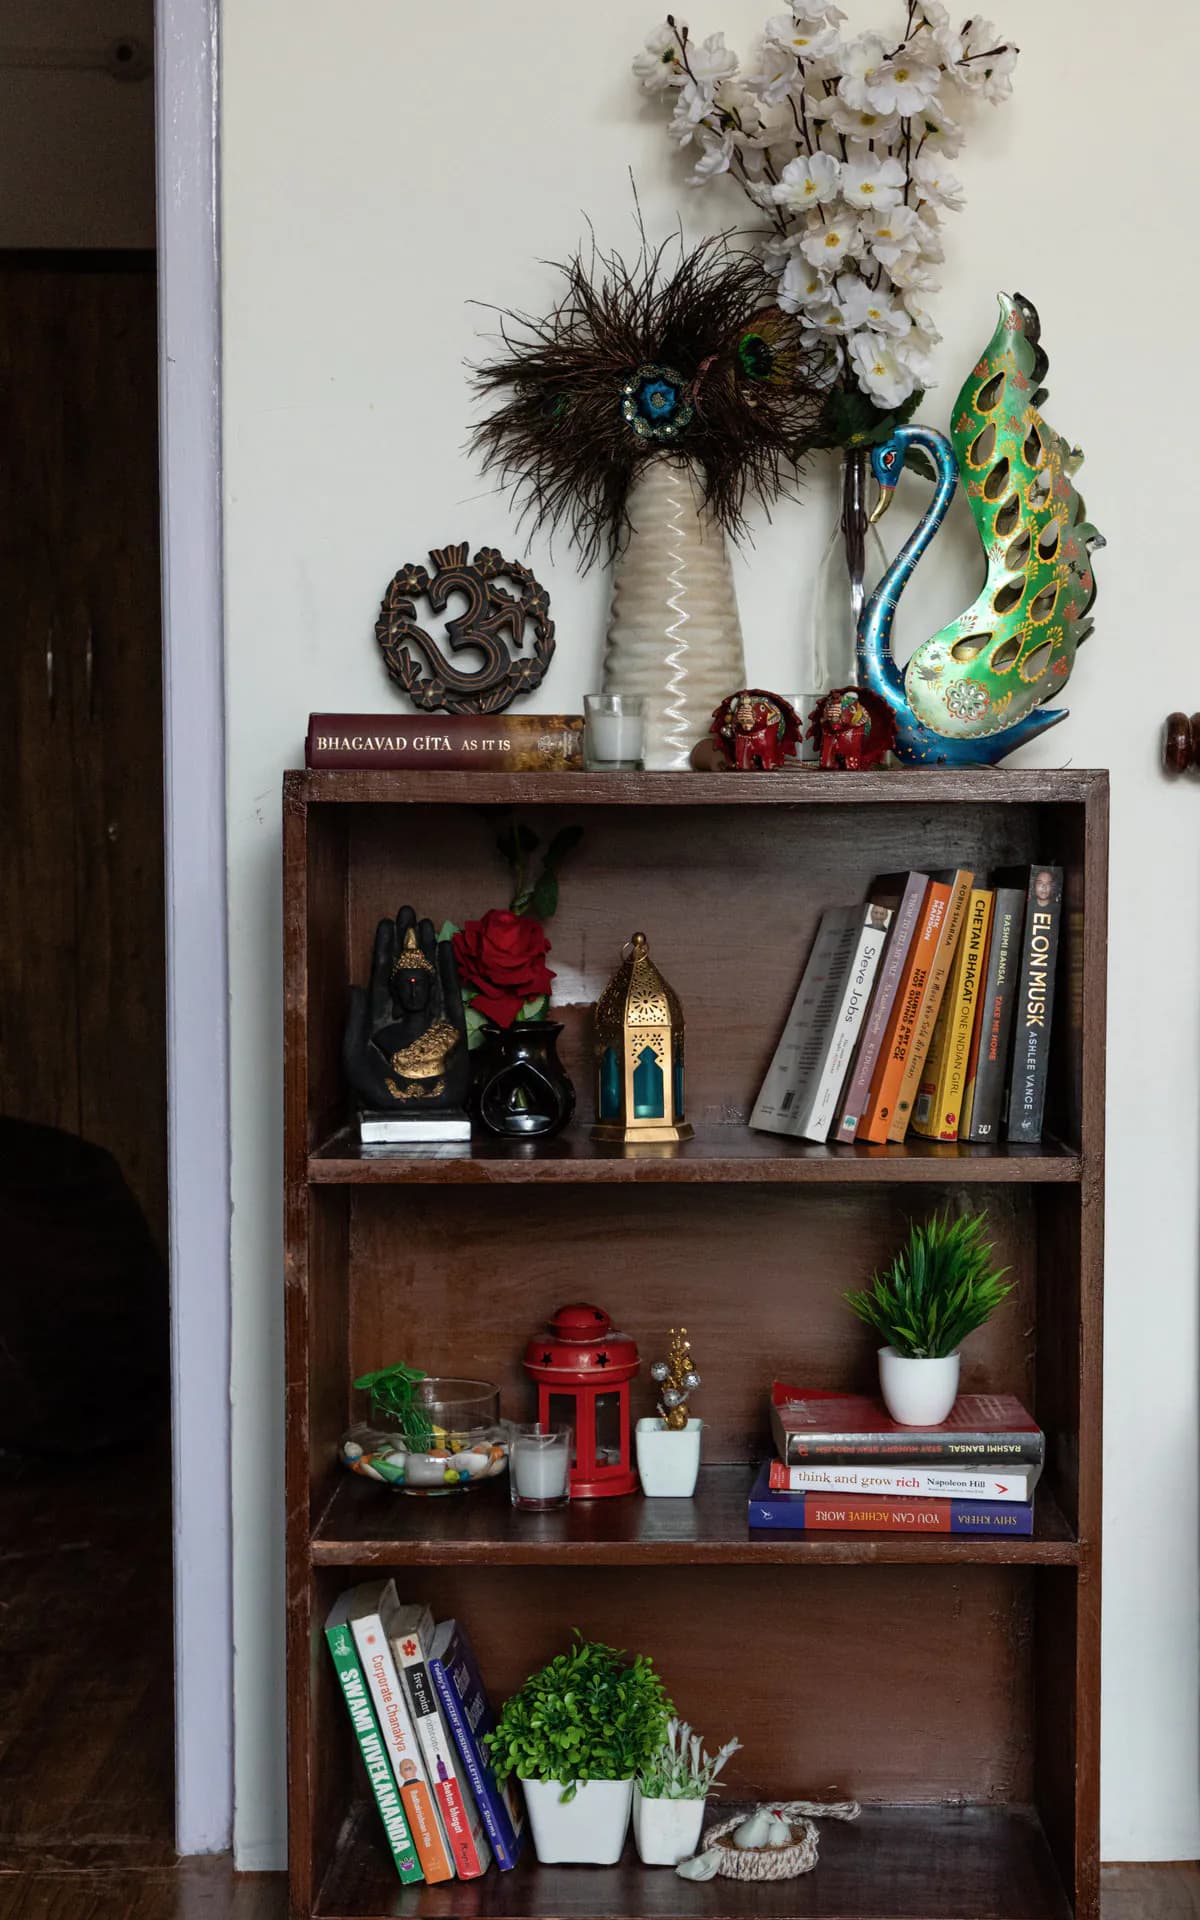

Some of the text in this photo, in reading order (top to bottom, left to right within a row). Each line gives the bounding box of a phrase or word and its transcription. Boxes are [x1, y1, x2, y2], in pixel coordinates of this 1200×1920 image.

[316, 736, 407, 751] BHAGAVAD
[460, 739, 478, 751] AS
[481, 739, 495, 751] IT
[498, 739, 511, 751] IS
[923, 898, 939, 941] MANSON
[932, 900, 944, 928] MARK
[944, 883, 967, 946] ROBIN SHARMA
[844, 945, 876, 1023] Steve Jobs
[911, 967, 921, 987] NOT
[949, 899, 985, 1096] CHETAN BHAGAT ONE INDIAN GIRL
[988, 914, 1011, 1061] RASHMI BANSAL TAKE ME HOME
[897, 969, 927, 1062] THE SUBTLE ART OF
[899, 1023, 907, 1032] A
[902, 989, 915, 1023] GIVING
[1022, 912, 1052, 1110] ELON MUSK ASHLEE VANCE
[948, 1444, 984, 1452] BANSAL
[986, 1444, 1020, 1452] RASHMI
[798, 1472, 831, 1484] think
[834, 1473, 857, 1485] and
[861, 1476, 893, 1489] grow
[895, 1476, 920, 1488] rich
[927, 1478, 967, 1489] Napoleon
[969, 1479, 986, 1488] Hill
[815, 1510, 1016, 1525] SHIV KHERA YOU CAN ACHIEVE MORE
[369, 1653, 409, 1753] Corporate Chanakya
[412, 1671, 433, 1715] five point
[338, 1667, 412, 1854] SWAMI VIVEKANANDA
[441, 1689, 460, 1727] EFFICIENT
[454, 1727, 473, 1764] BUSINESS
[467, 1763, 484, 1794] LETTERS
[482, 1808, 498, 1837] Sharma
[441, 1780, 464, 1834] chetan bhagat
